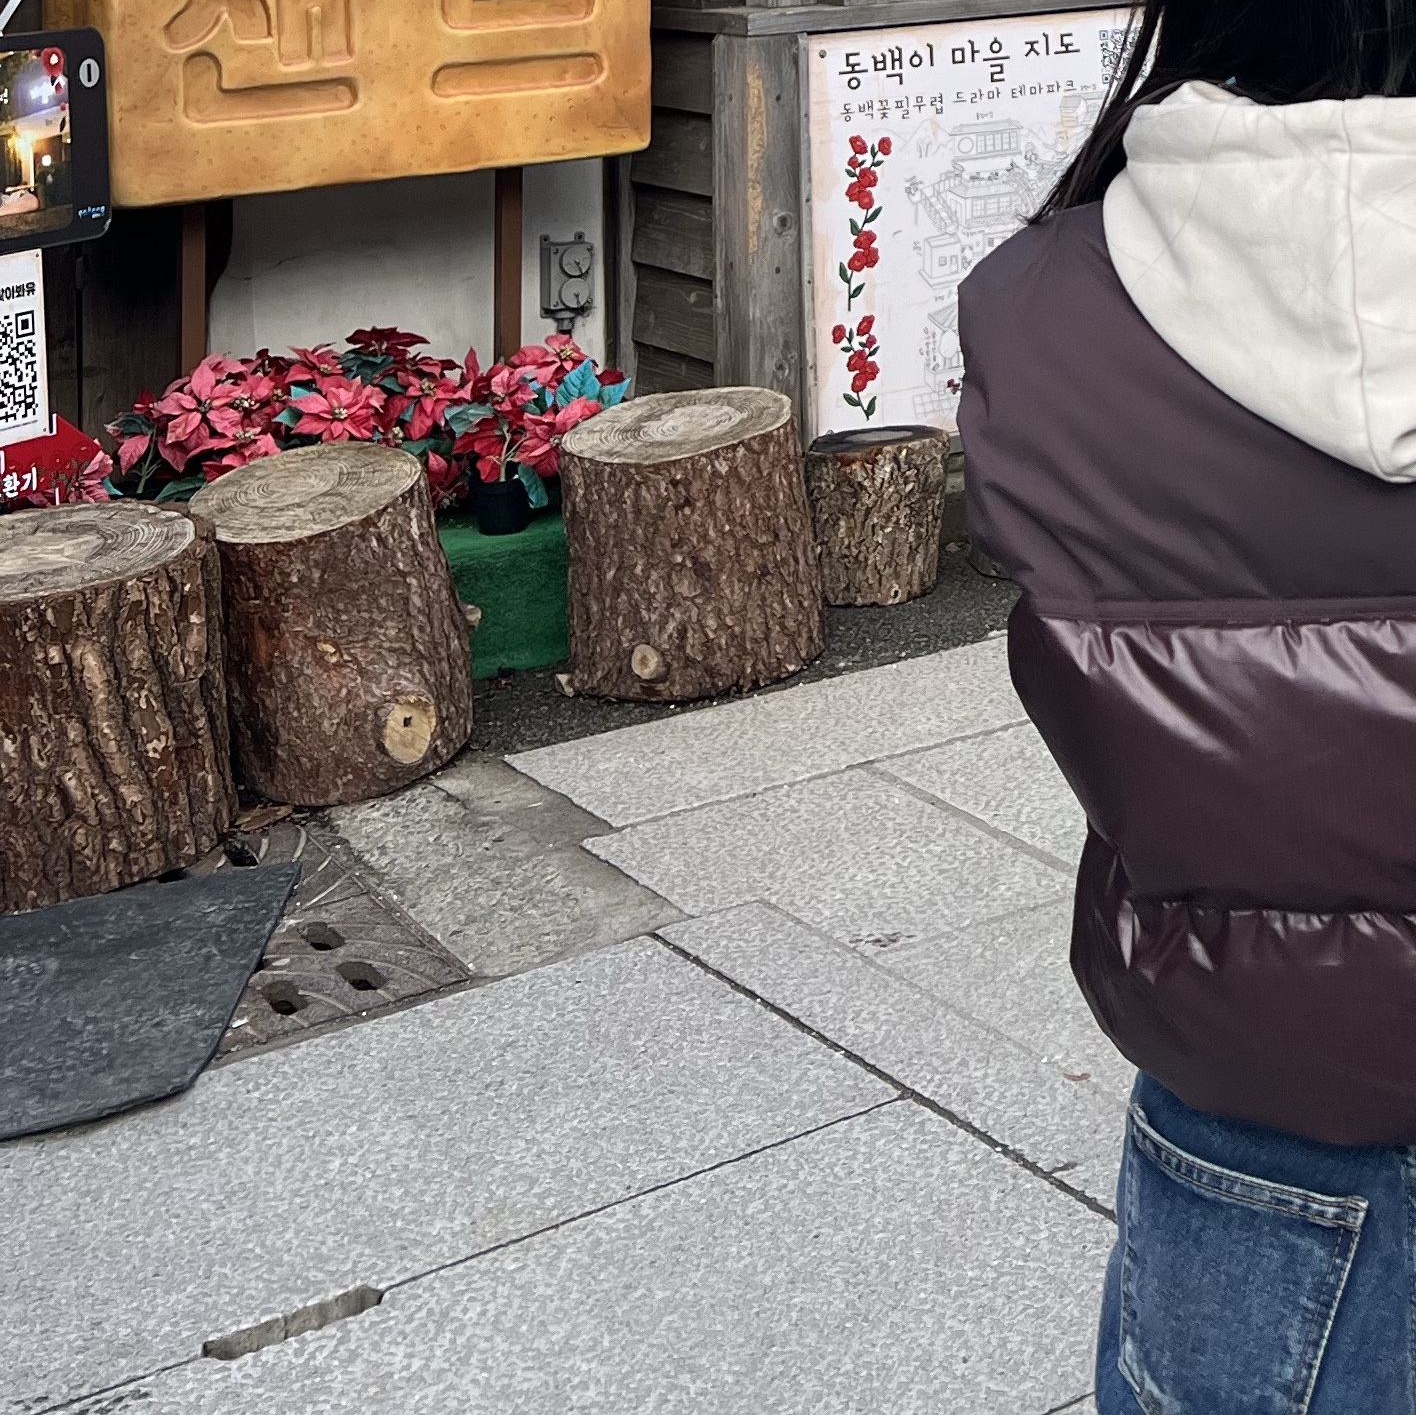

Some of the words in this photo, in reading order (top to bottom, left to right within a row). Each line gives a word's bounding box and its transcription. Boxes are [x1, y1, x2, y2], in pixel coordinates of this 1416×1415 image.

[839, 42, 934, 90] 동백이
[952, 36, 1010, 83] 마을
[1024, 32, 1080, 57] 지도
[953, 87, 1000, 103] 드라마
[1011, 80, 1077, 98] 테마파크
